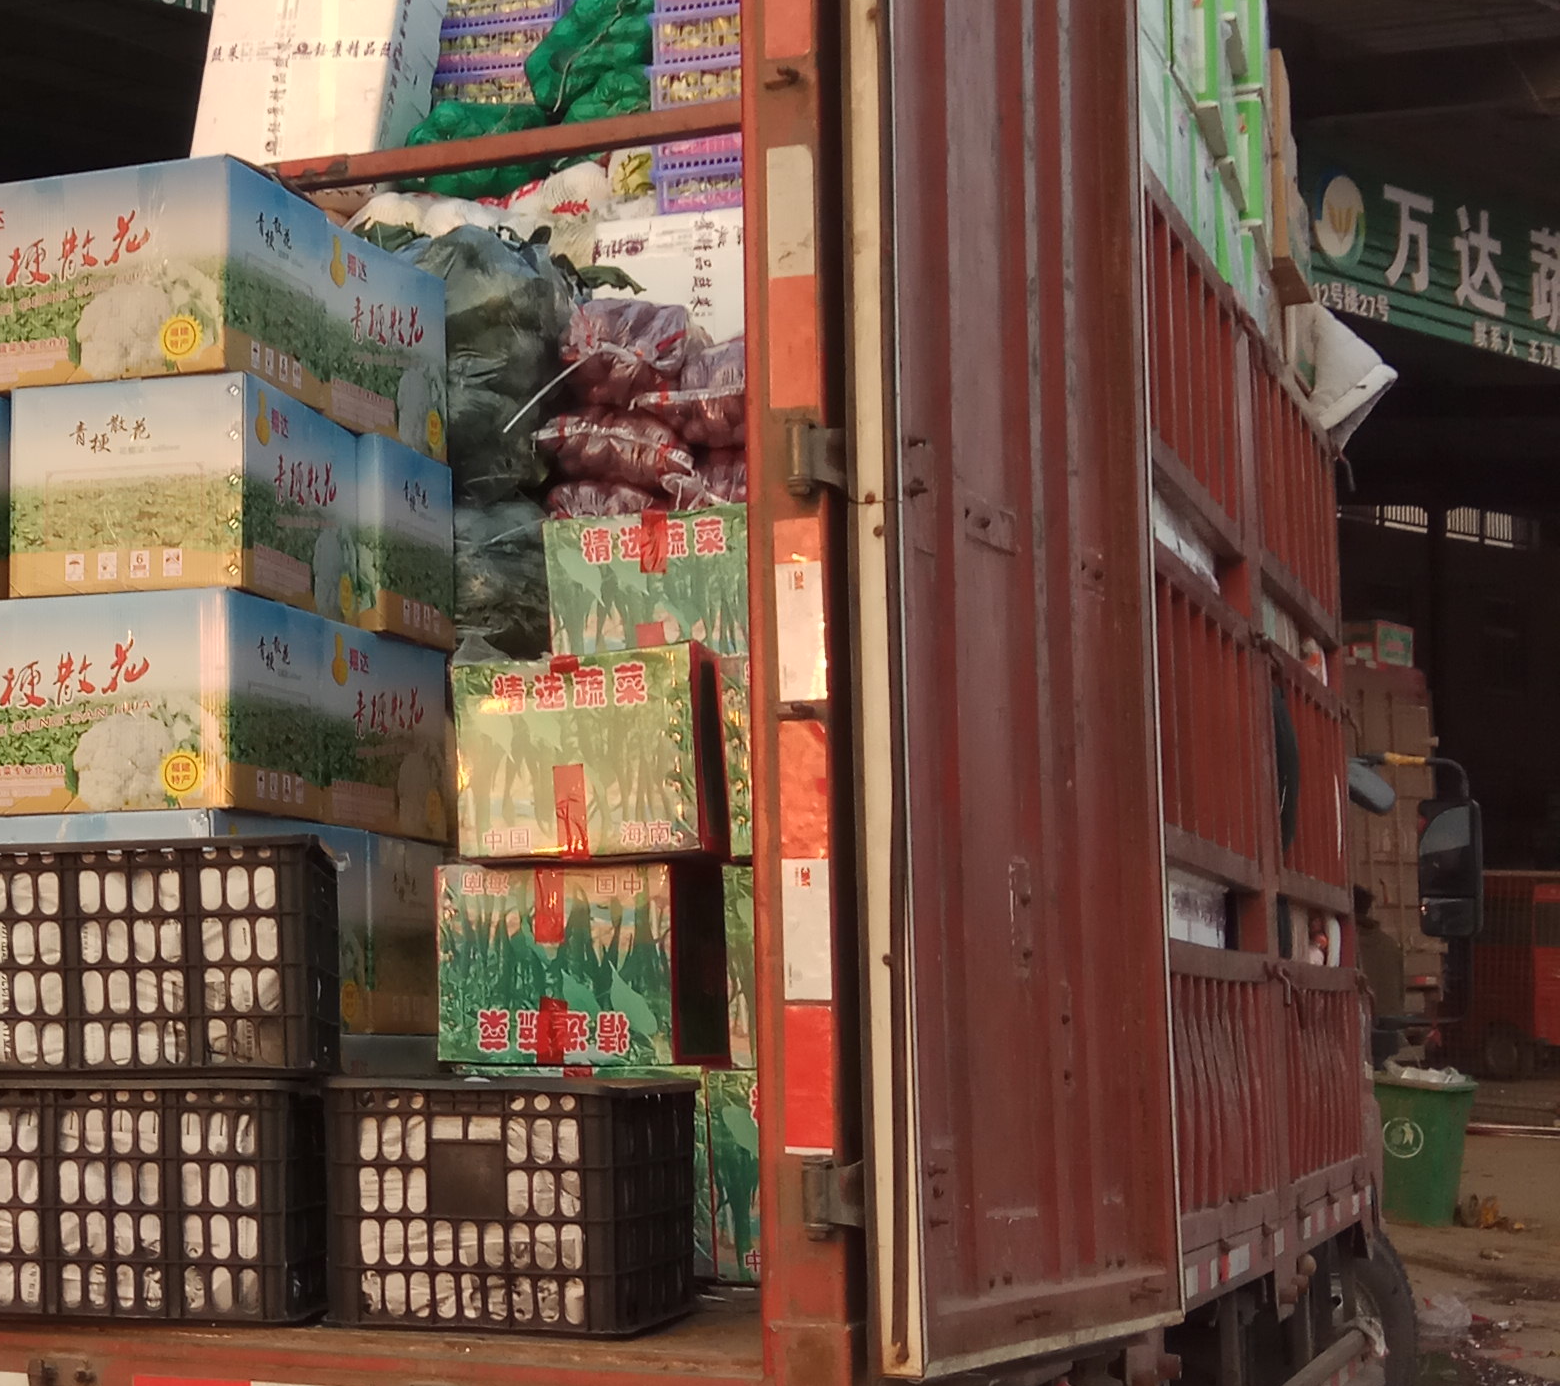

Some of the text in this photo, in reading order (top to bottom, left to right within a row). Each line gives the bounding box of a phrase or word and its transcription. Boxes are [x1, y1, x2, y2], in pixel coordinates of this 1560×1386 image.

[492, 663, 647, 714] 精选蔬菜
[484, 821, 672, 851] 中国 海南
